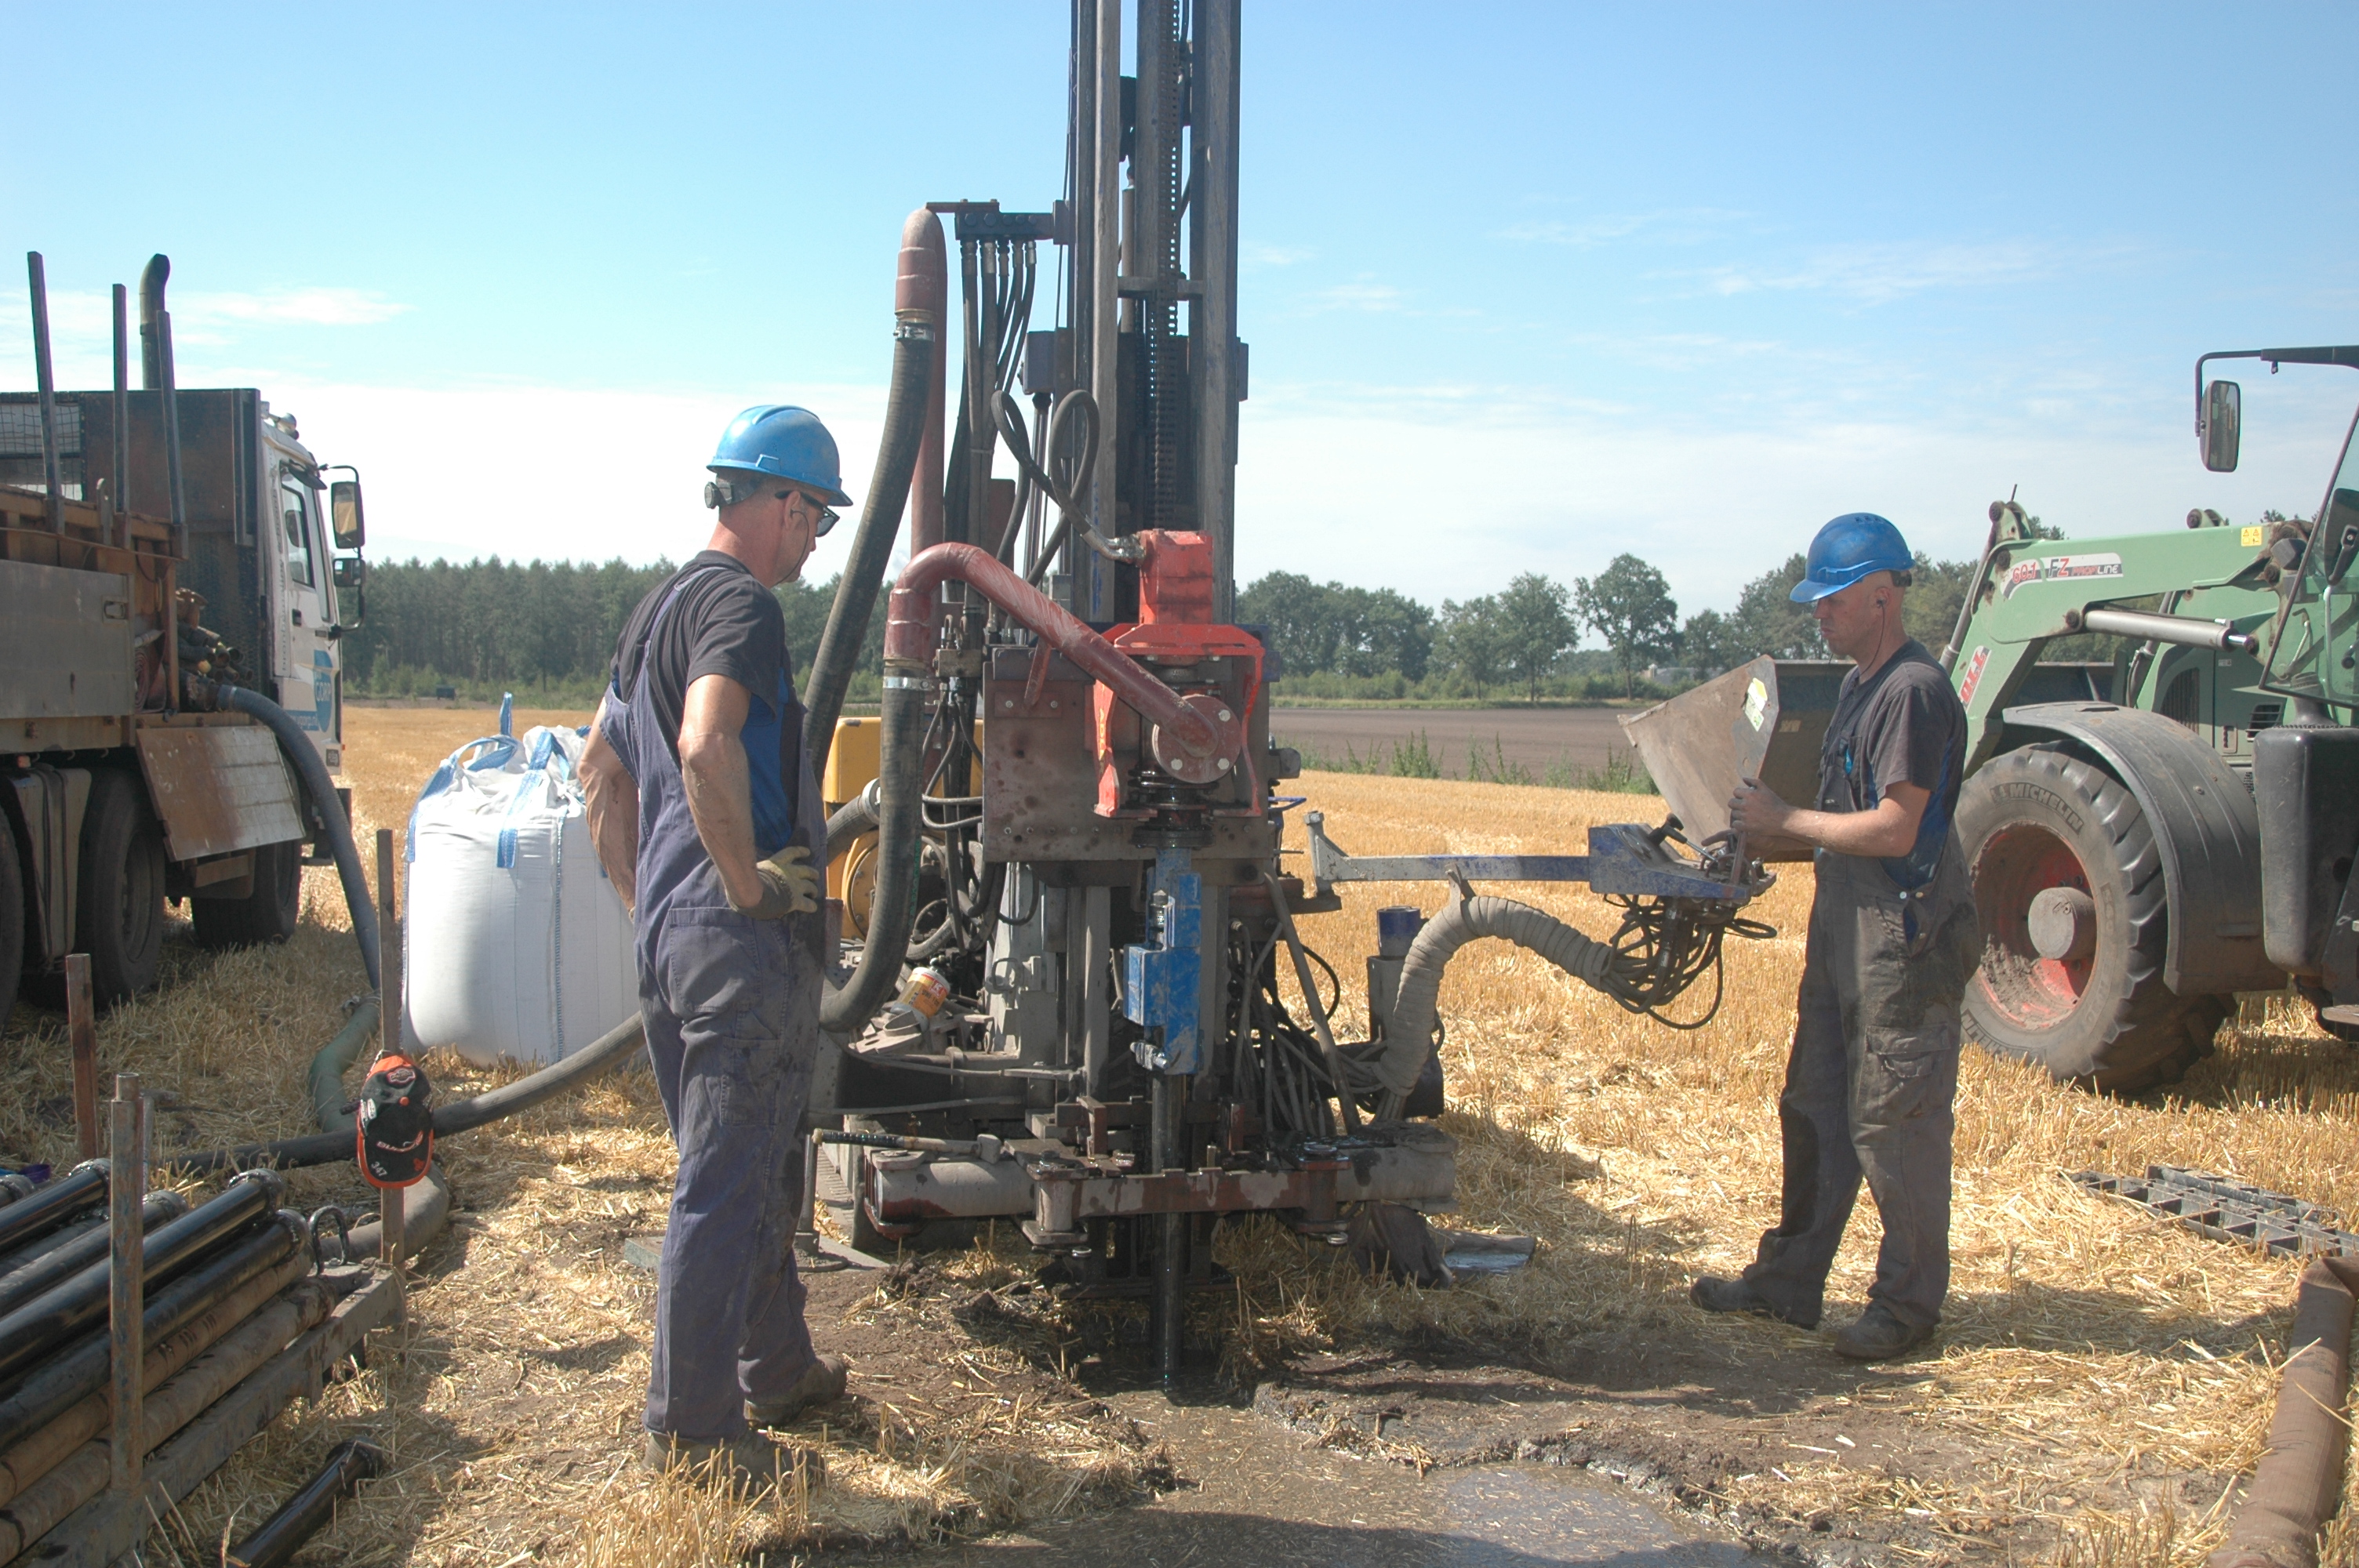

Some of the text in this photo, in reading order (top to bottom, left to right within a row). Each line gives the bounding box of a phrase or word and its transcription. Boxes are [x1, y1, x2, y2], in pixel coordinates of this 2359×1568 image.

[2012, 562, 2037, 583] 60.1
[2048, 557, 2069, 578] FZ
[2009, 783, 2084, 832] MICHELIN
[371, 1161, 387, 1176] 347
